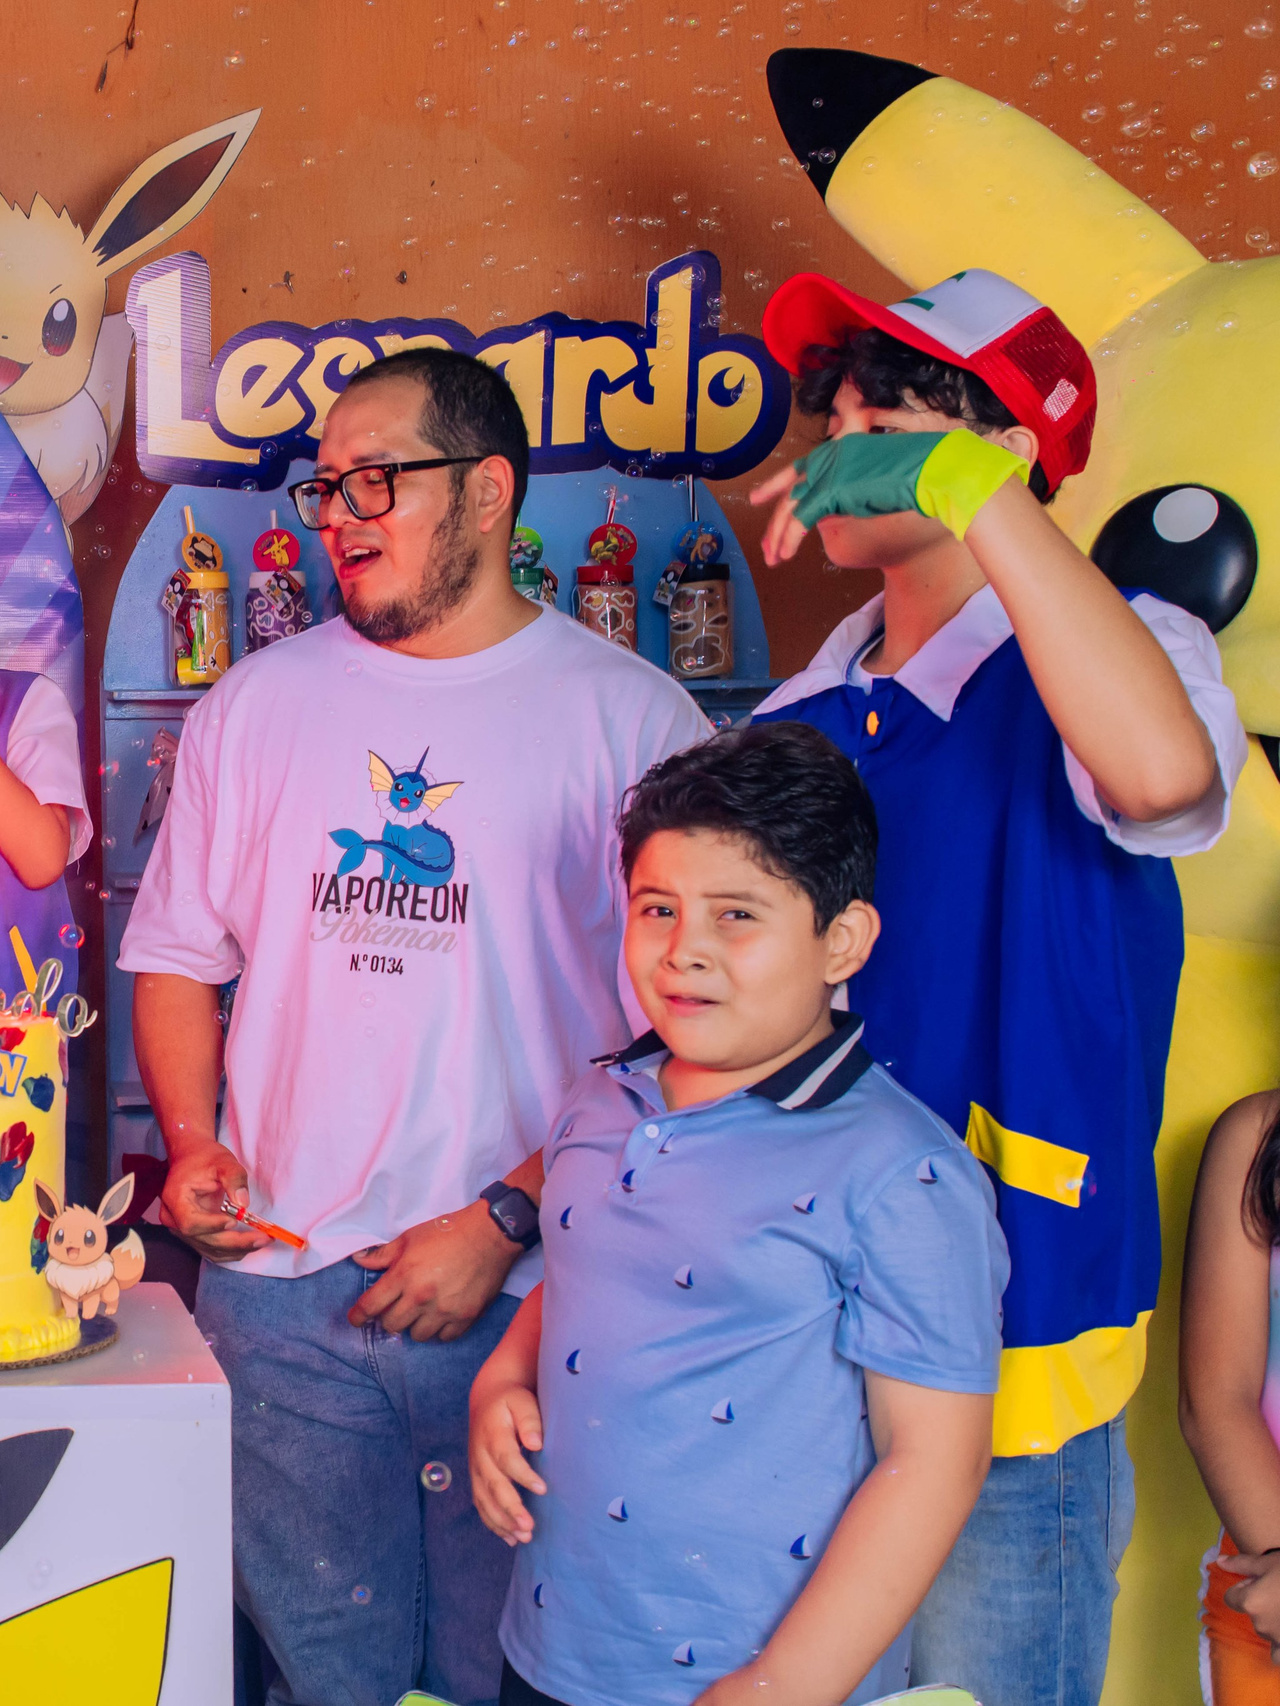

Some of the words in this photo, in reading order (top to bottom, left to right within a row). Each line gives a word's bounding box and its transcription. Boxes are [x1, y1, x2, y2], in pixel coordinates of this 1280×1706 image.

[132, 260, 768, 468] Leoardo
[311, 872, 469, 924] VAPOREON
[309, 903, 458, 954] Pokémon
